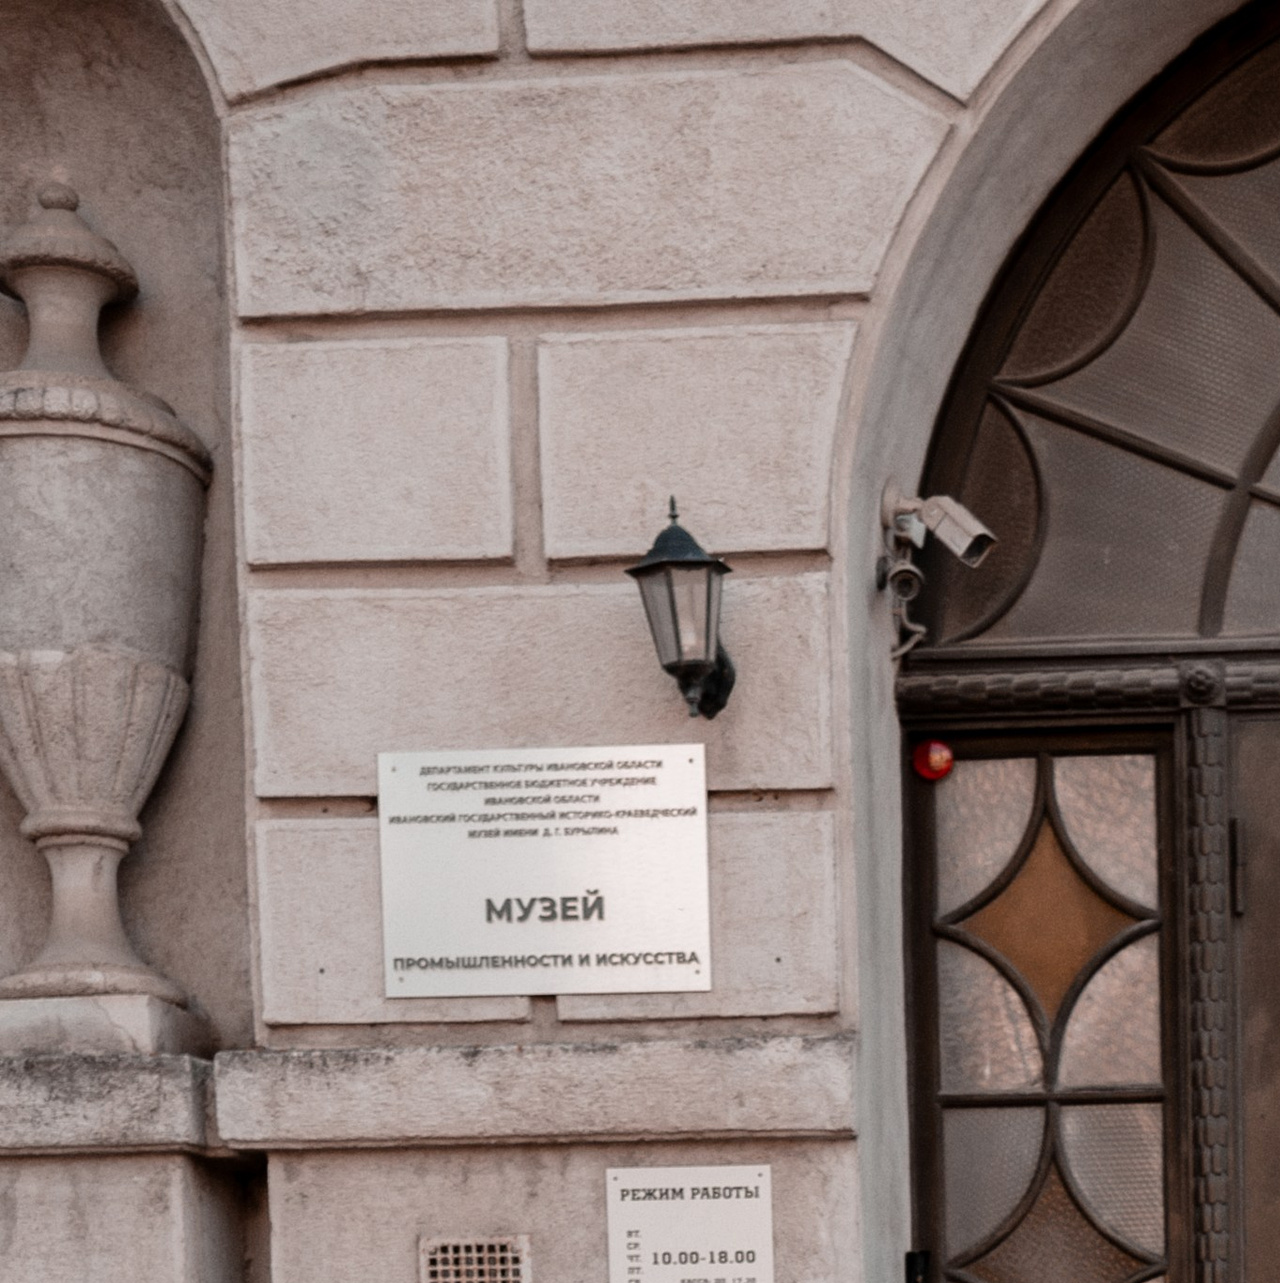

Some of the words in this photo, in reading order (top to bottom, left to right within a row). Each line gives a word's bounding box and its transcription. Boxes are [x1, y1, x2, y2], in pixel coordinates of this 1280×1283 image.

[493, 764, 543, 774] КУЛЬТУРЫ
[547, 760, 614, 771] ИВАНОВСКОЙ
[617, 760, 663, 770] ОБЛАСТИ
[427, 780, 521, 791] ГОСУДАРСТВЕННОЕ
[525, 778, 588, 789] БЮДЖЕТНОЕ
[591, 777, 657, 787] УЧРЕЖДЕНИЕ
[484, 794, 551, 805] ИВАНОВСКОЙ
[554, 795, 600, 804] ОБЛАСТИ
[388, 812, 455, 824] ИВАНОВСКИЙ
[458, 810, 555, 823] ГОСУДАРСТВЕННЫЙ
[468, 827, 500, 838] МУЗЕЙ
[503, 828, 538, 838] ИМЕНИ
[485, 889, 606, 923] МУЗЕЙ
[393, 954, 573, 971] ПРОМЫШЛЕННОСТИ
[579, 953, 591, 967] И
[596, 951, 700, 967] ИСКУССТВА
[620, 1187, 685, 1201] РЕЖИМ
[690, 1186, 760, 1200] РАБОТЫ
[652, 1250, 756, 1265] 10.00-18.00
